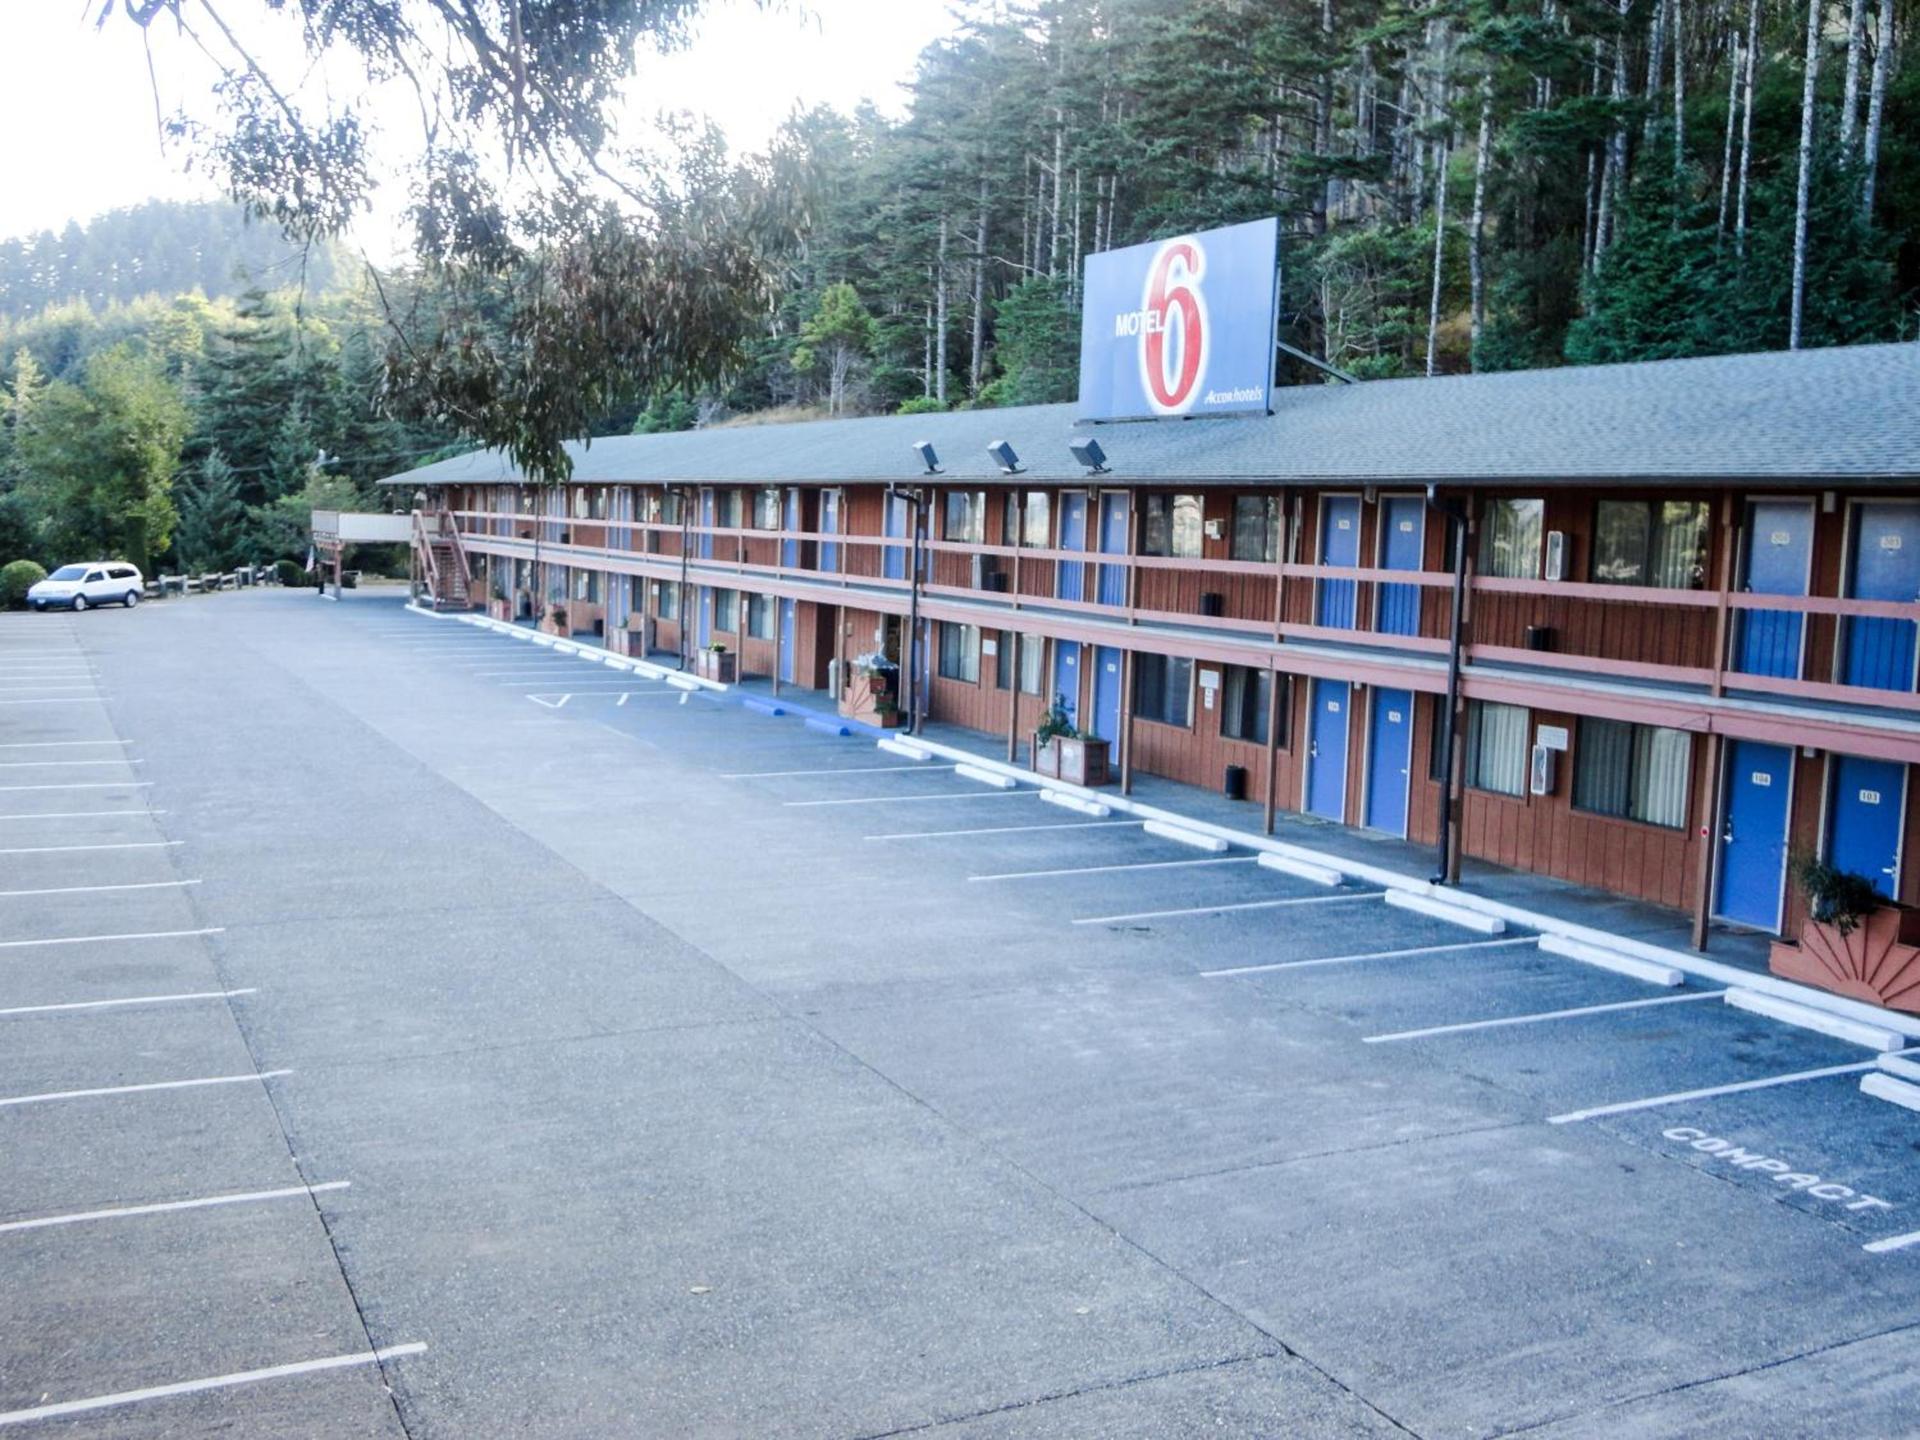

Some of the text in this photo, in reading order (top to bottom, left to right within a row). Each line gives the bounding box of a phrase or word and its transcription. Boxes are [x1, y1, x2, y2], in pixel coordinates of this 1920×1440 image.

[1115, 242, 1203, 408] MOTEL 6
[1661, 1126, 1894, 1212] COMPACT
